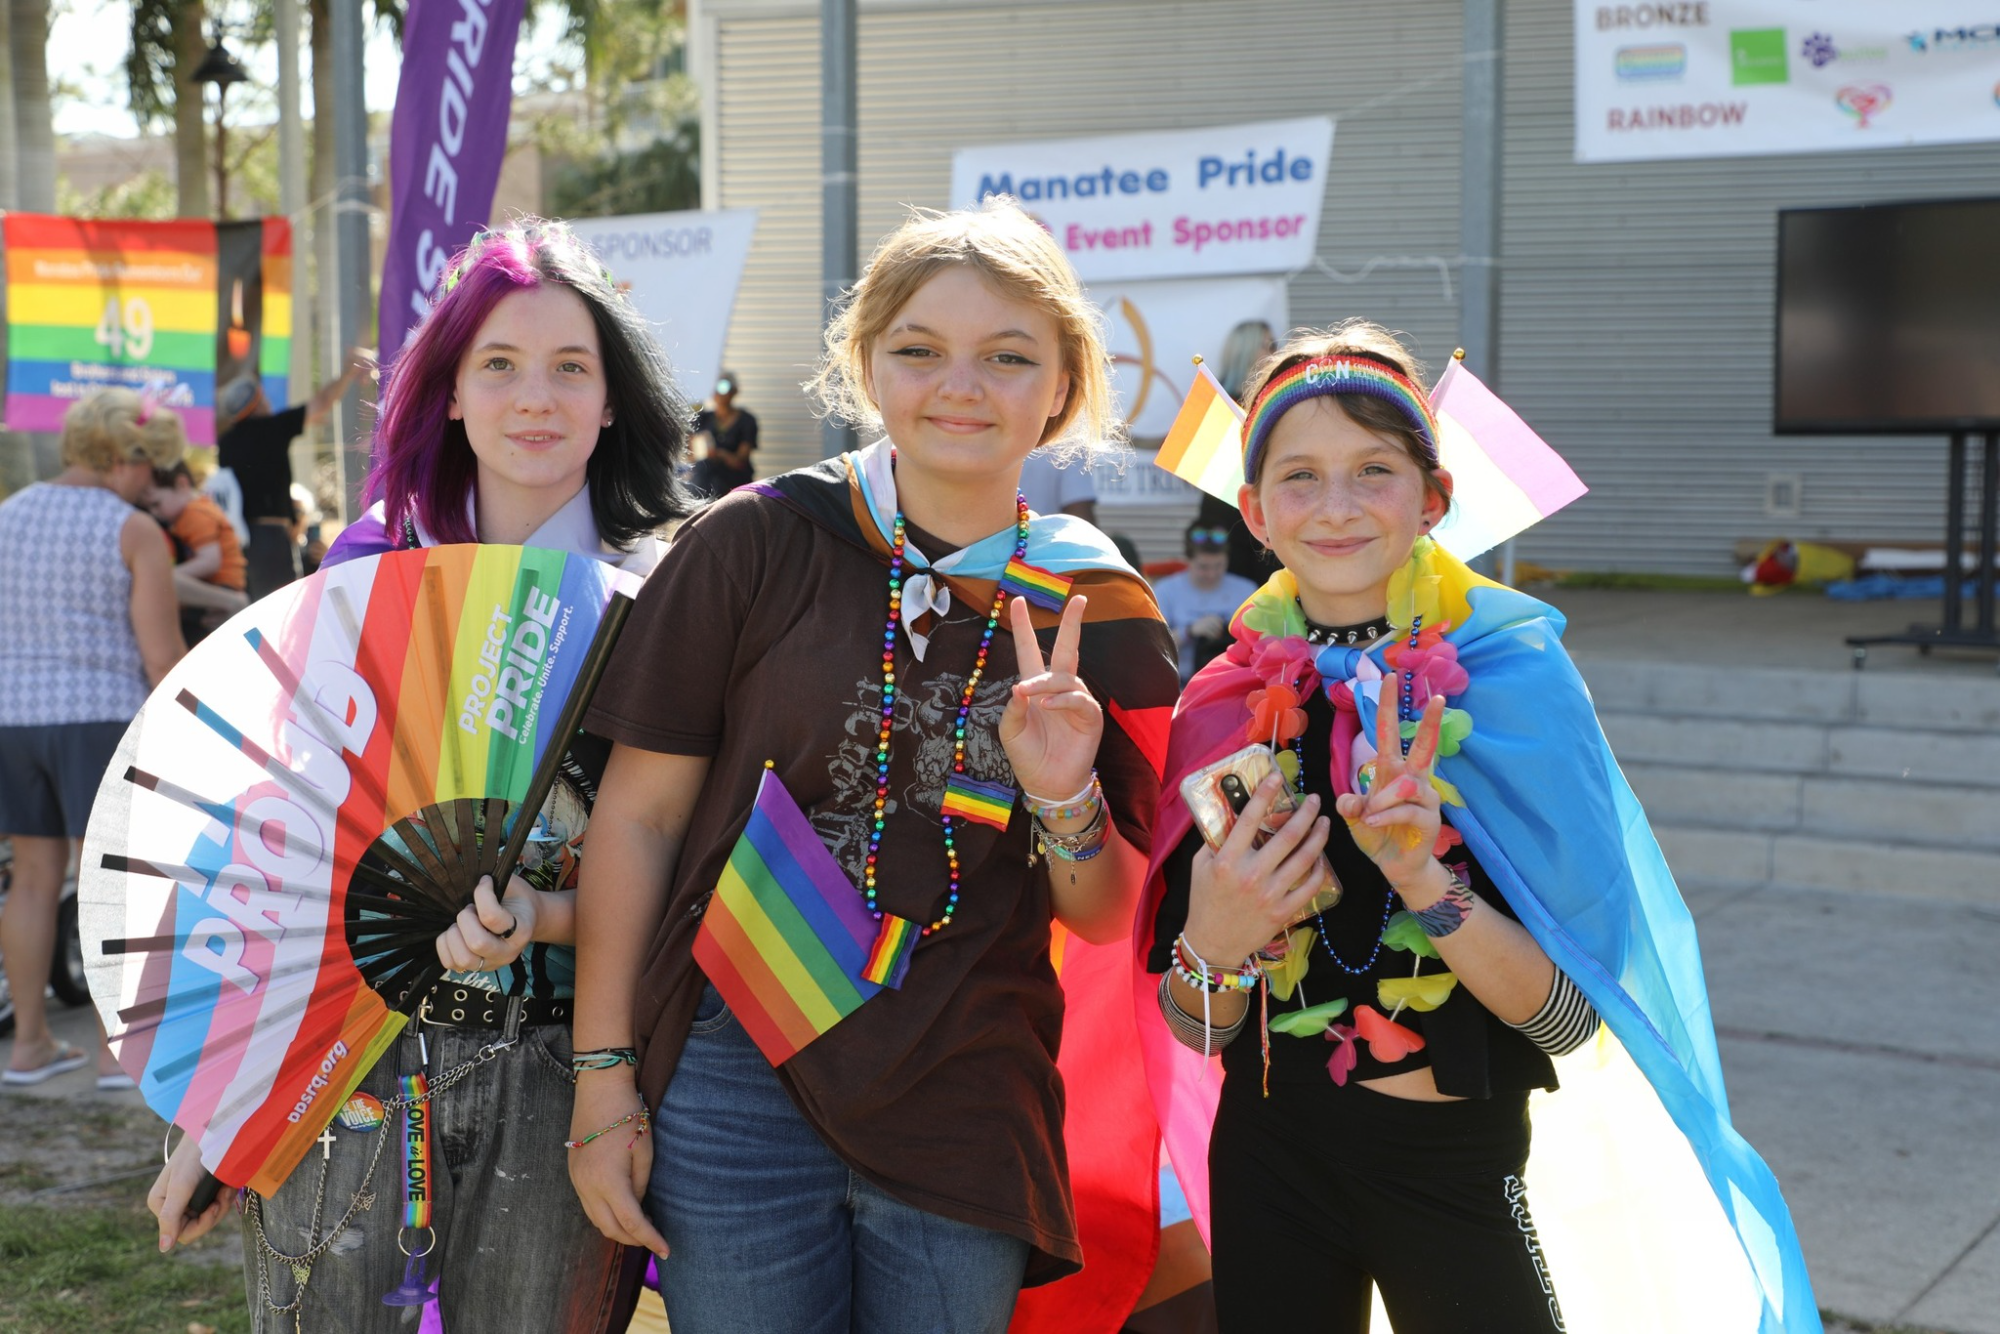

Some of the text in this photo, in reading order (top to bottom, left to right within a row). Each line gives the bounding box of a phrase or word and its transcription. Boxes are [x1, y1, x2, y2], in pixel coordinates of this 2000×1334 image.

[1595, 2, 1710, 31] BRONZE
[424, 0, 491, 227] RIDE
[1606, 102, 1749, 132] RAINBOW
[977, 148, 1313, 203] Manatee Pride
[591, 226, 714, 260] SPONSOR
[1065, 219, 1153, 252] Event
[1172, 212, 1306, 251] Sponsor
[94, 296, 154, 360] 49
[458, 604, 513, 735] PROJECT
[485, 585, 561, 740] PRIDE
[518, 605, 574, 745] Celebrate. Unite. Support.
[181, 660, 378, 995] PROUD
[287, 1040, 348, 1123] ppsrq.org
[340, 1106, 377, 1127] VOICE
[407, 1160, 426, 1202] LOVE
